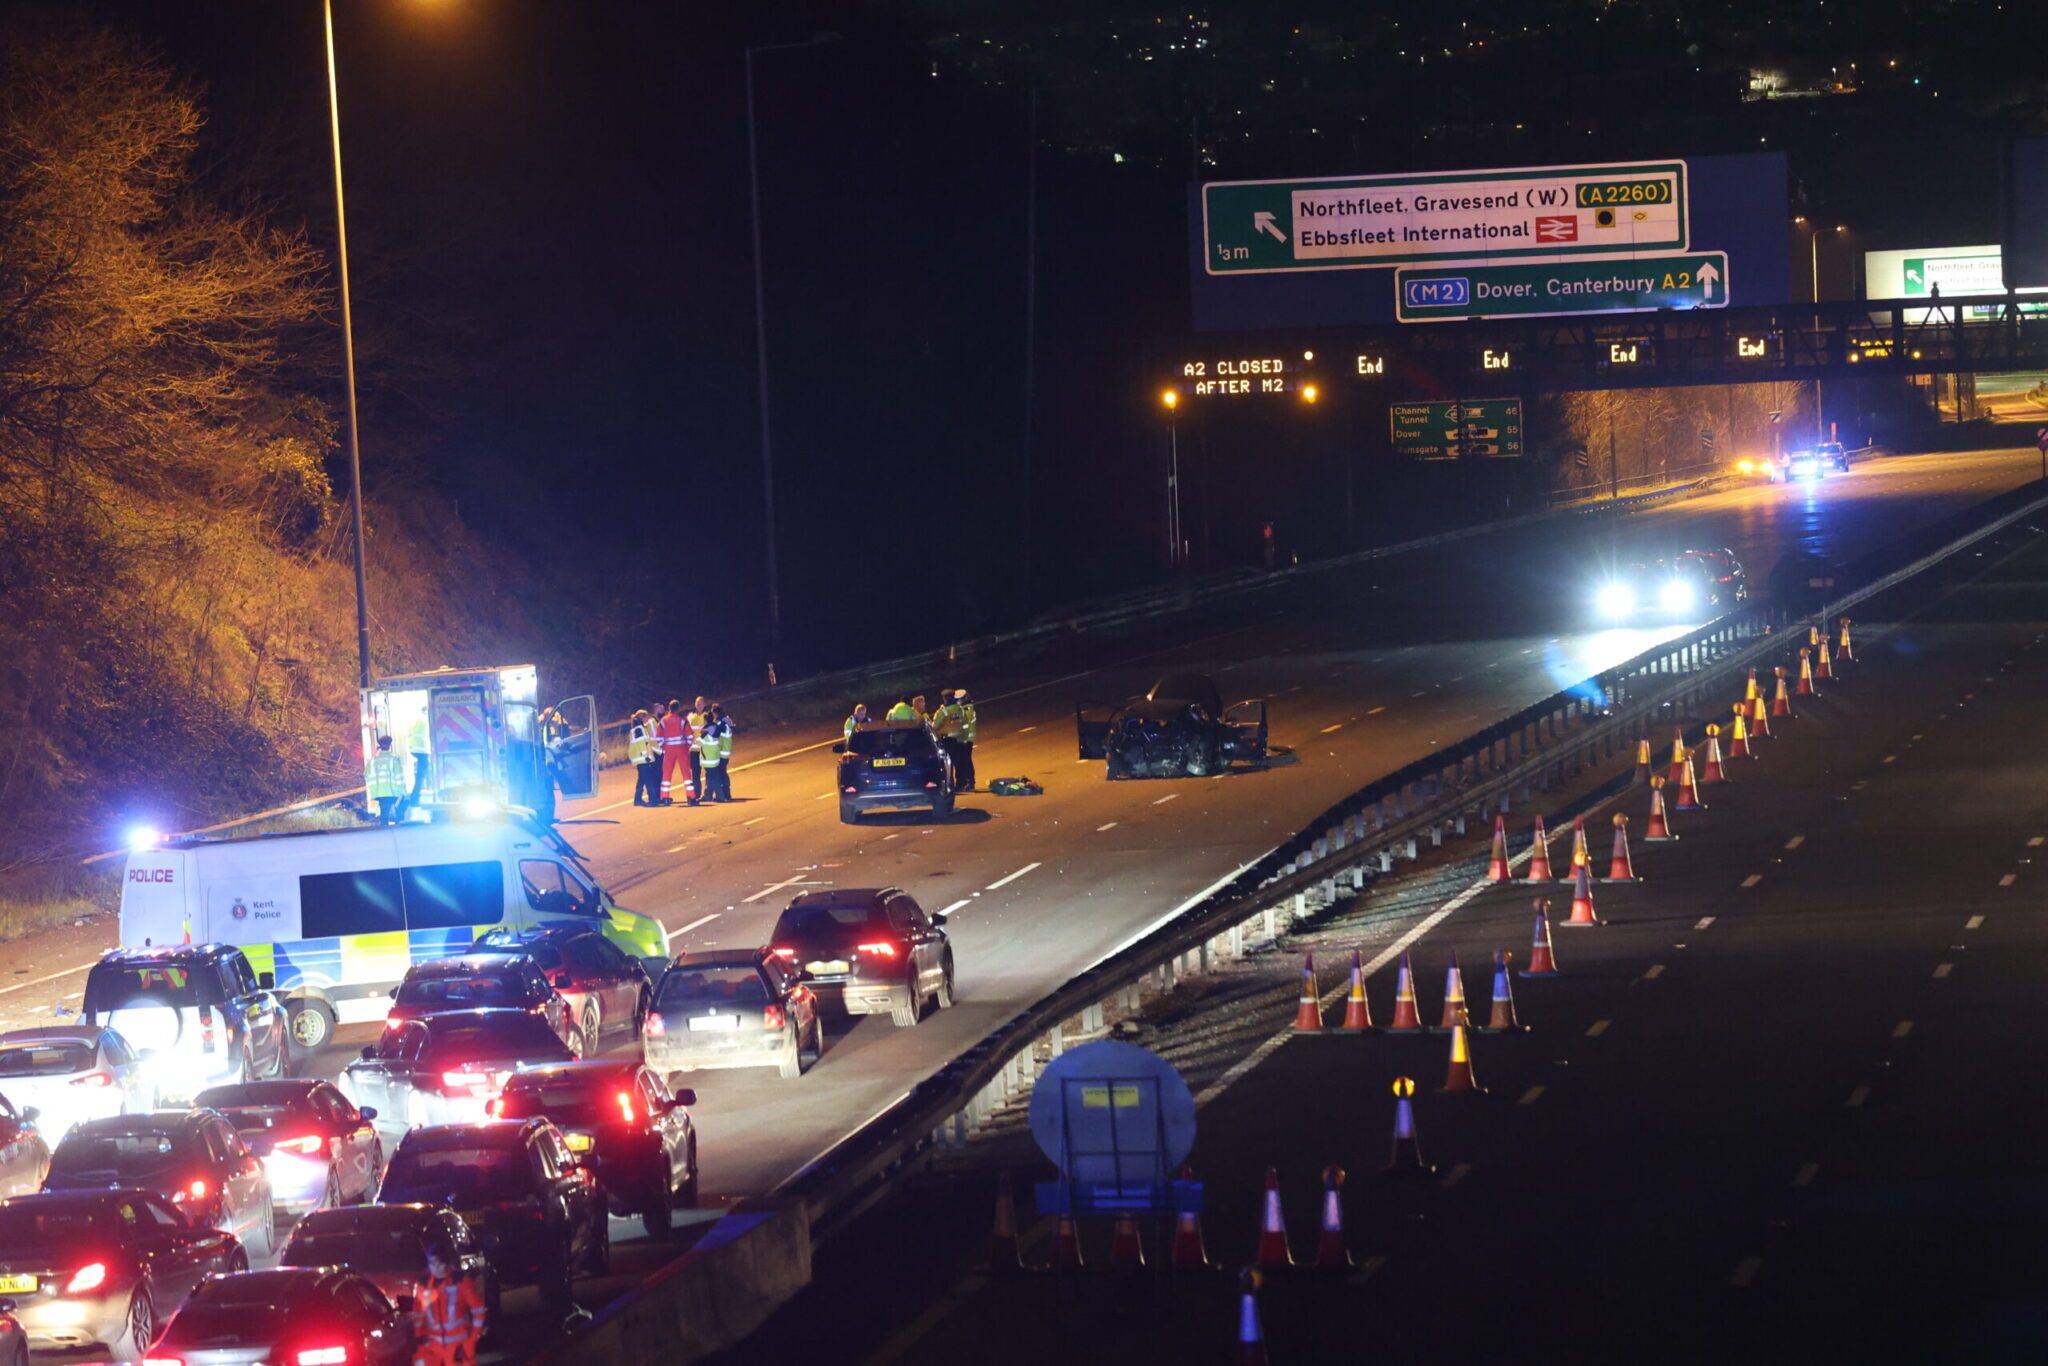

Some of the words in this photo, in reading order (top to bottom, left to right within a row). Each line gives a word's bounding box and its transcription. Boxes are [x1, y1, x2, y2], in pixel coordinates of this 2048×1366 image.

[1414, 191, 1519, 212] Gravesend
[1526, 187, 1569, 208] (W)
[1579, 182, 1669, 206] (A2260)
[1301, 227, 1395, 247] Ebbsfleet
[1403, 222, 1529, 242] International
[1410, 281, 1465, 303] (M2)
[1547, 276, 1655, 295] Canterbury
[1662, 273, 1690, 290] A2
[1611, 344, 1636, 362] End
[1739, 337, 1765, 356] End
[1184, 362, 1206, 377] A2
[1217, 359, 1283, 375] CLOSED
[1358, 355, 1382, 373] End
[1484, 350, 1509, 368] End
[1196, 380, 1250, 395] AFTER
[1262, 378, 1284, 393] M2
[1394, 405, 1430, 415] Channel
[1505, 407, 1518, 415] 46
[1400, 415, 1428, 424] Tunnel
[1396, 430, 1421, 438] Dover
[129, 869, 174, 883] POLICE
[253, 900, 274, 909] Kent
[254, 911, 281, 919] Police
